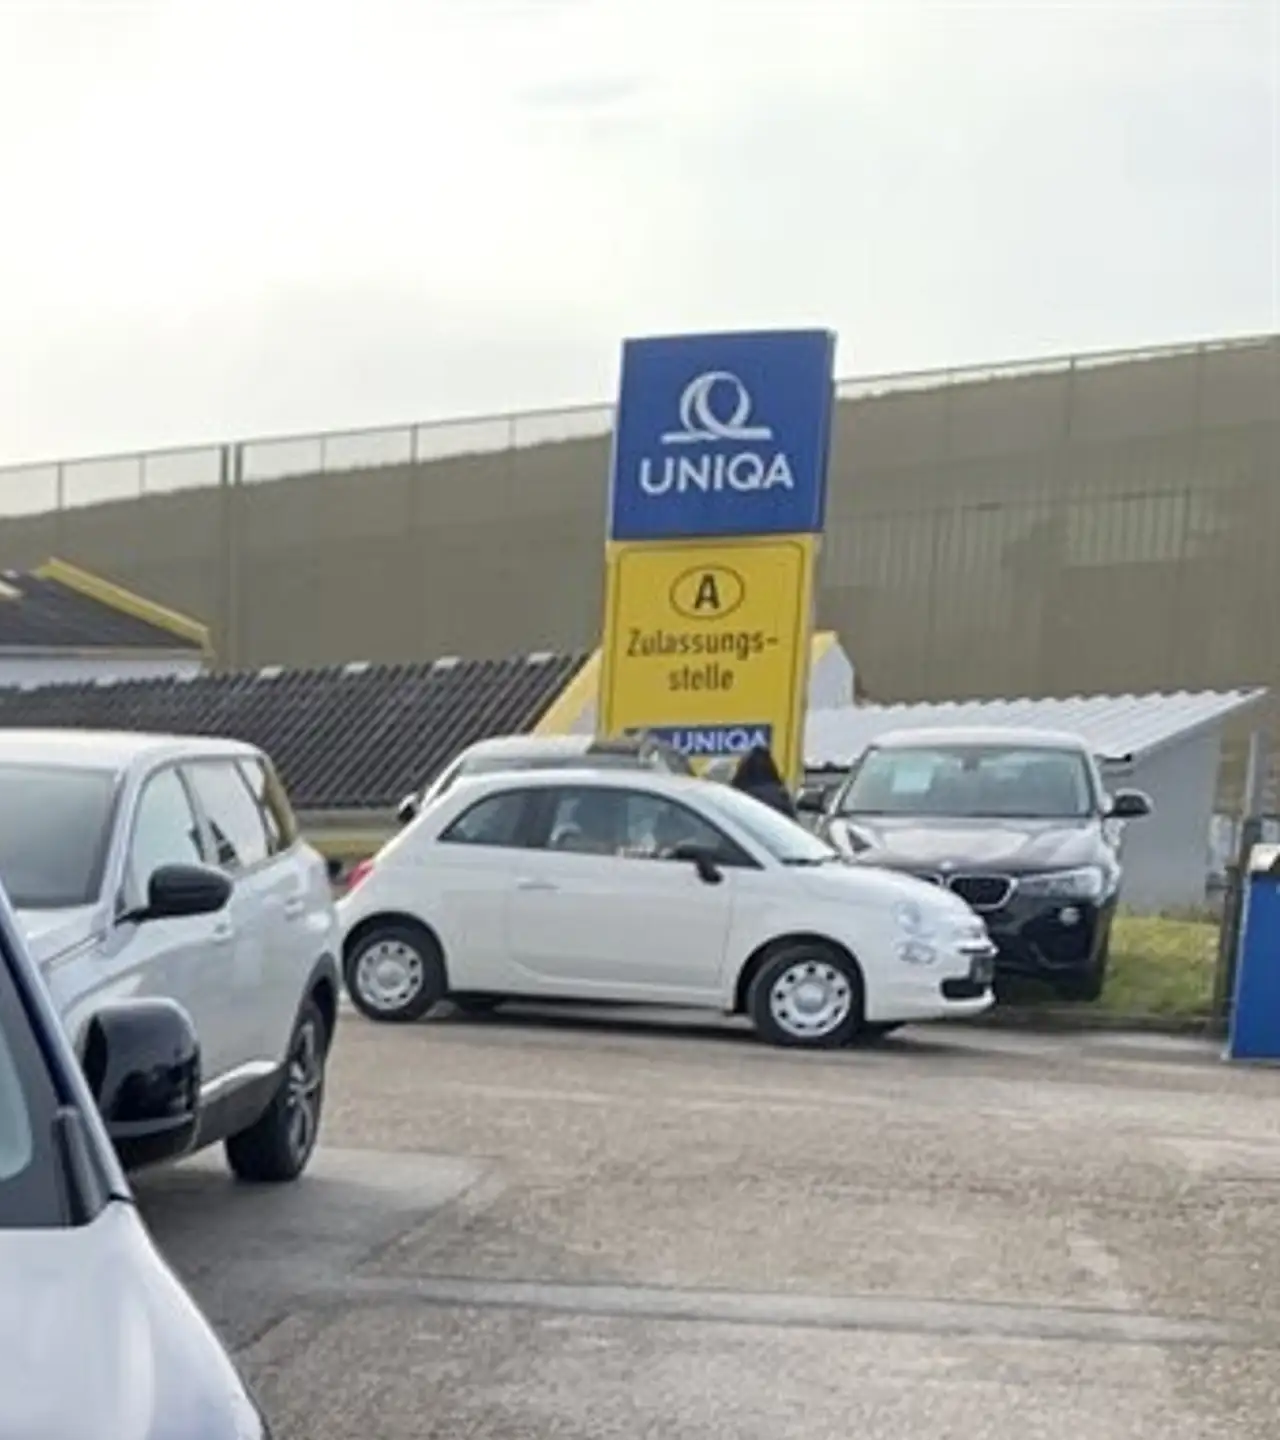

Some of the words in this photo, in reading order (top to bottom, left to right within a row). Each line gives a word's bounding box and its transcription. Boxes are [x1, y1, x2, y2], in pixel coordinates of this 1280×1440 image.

[640, 452, 795, 495] UNIQA
[694, 572, 720, 610] A
[626, 627, 779, 661] Zulassungs-
[667, 662, 735, 691] stelle
[671, 728, 767, 754] UNIQA
